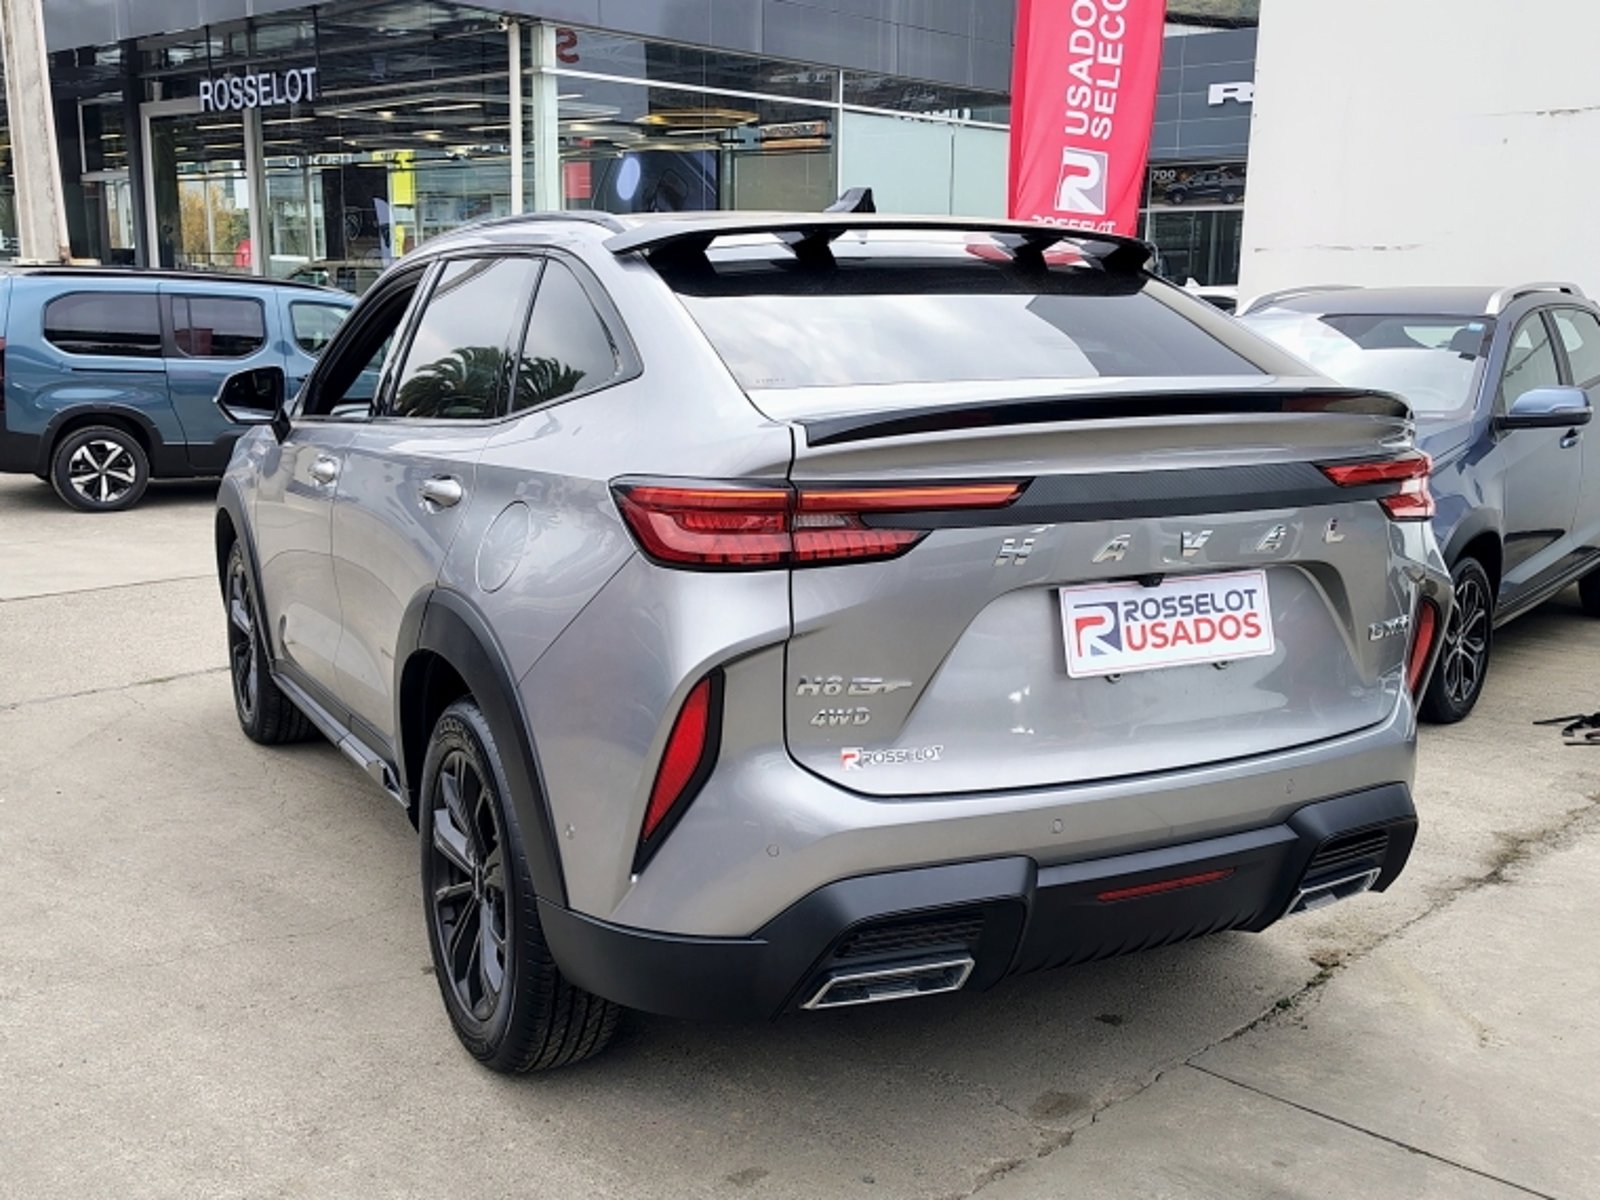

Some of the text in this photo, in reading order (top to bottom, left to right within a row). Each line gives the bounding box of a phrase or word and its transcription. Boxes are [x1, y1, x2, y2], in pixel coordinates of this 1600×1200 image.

[200, 67, 317, 112] ROSSELOT
[1153, 169, 1176, 180] 700
[993, 517, 1346, 566] HAVAL
[1123, 589, 1257, 622] ROSSELOT
[1126, 612, 1262, 651] USADOS
[796, 675, 843, 696] H6
[810, 707, 871, 726] 4WD
